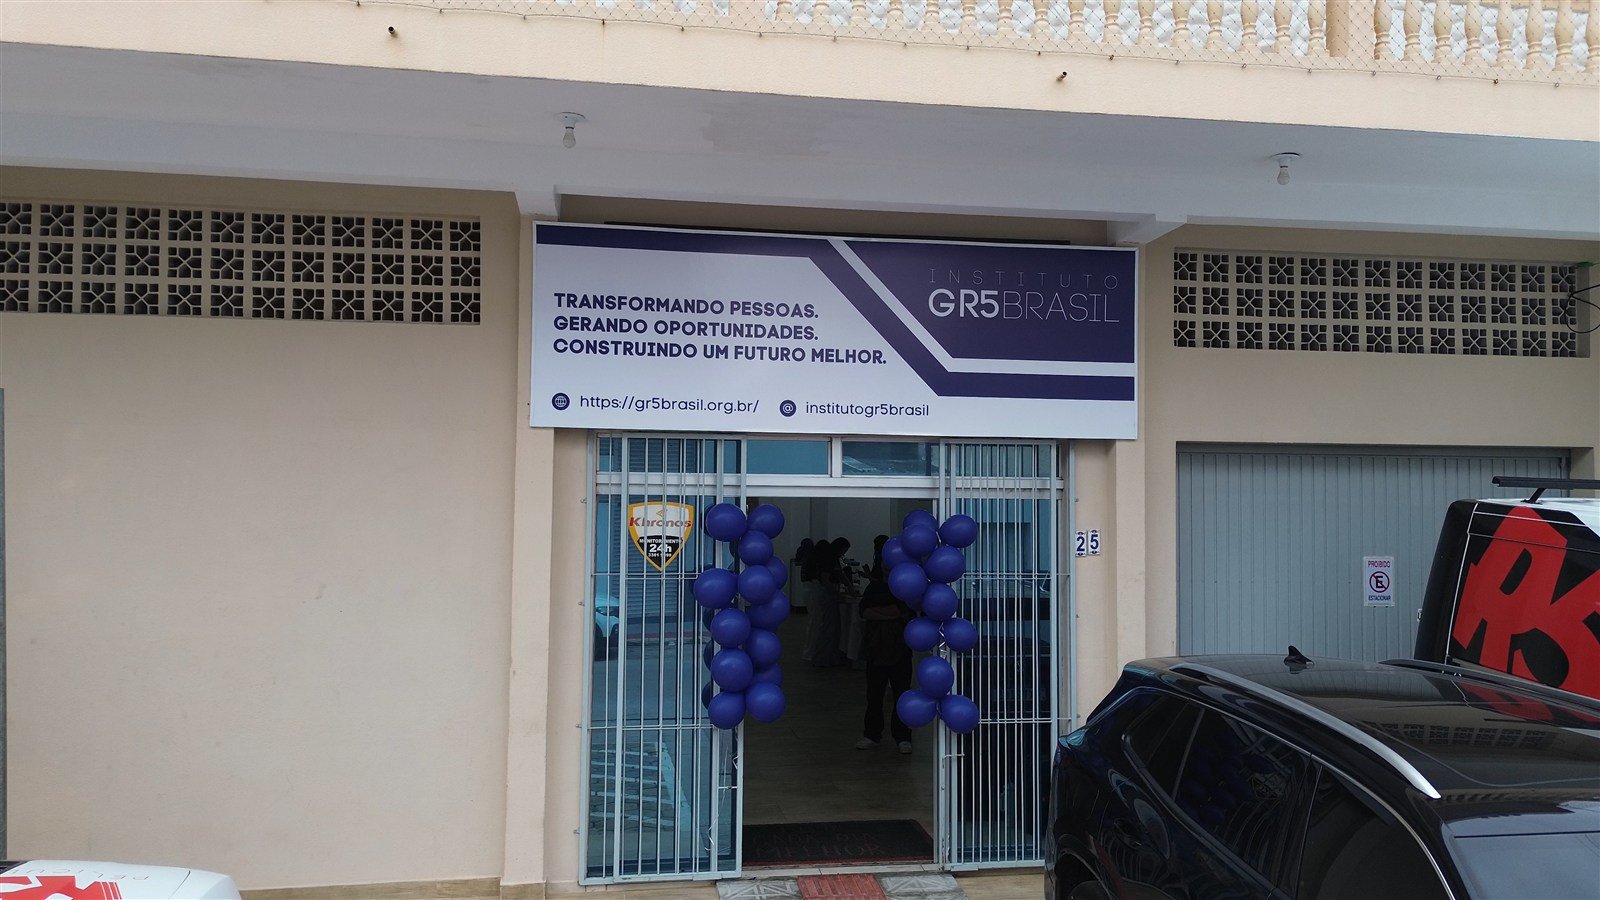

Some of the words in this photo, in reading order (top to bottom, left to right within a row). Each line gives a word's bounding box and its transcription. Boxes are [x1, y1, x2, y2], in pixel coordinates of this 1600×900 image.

[928, 267, 1120, 290] INSTITUTO
[553, 292, 725, 315] TRANSFORMANDO
[730, 301, 820, 319] PESSOAS.
[553, 315, 648, 335] GERANDO
[653, 319, 820, 341] OPORTUNIDADES.
[552, 338, 698, 359] CONSTRUINDO
[703, 344, 729, 360] UM
[734, 345, 806, 362] FUTURO
[811, 348, 887, 365] MELHOR.
[580, 395, 760, 413] https://gr5brasil.org.br/
[805, 401, 930, 418] institutogr5brasil
[1076, 533, 1099, 552] 25
[1367, 560, 1391, 568] PROIBIDO
